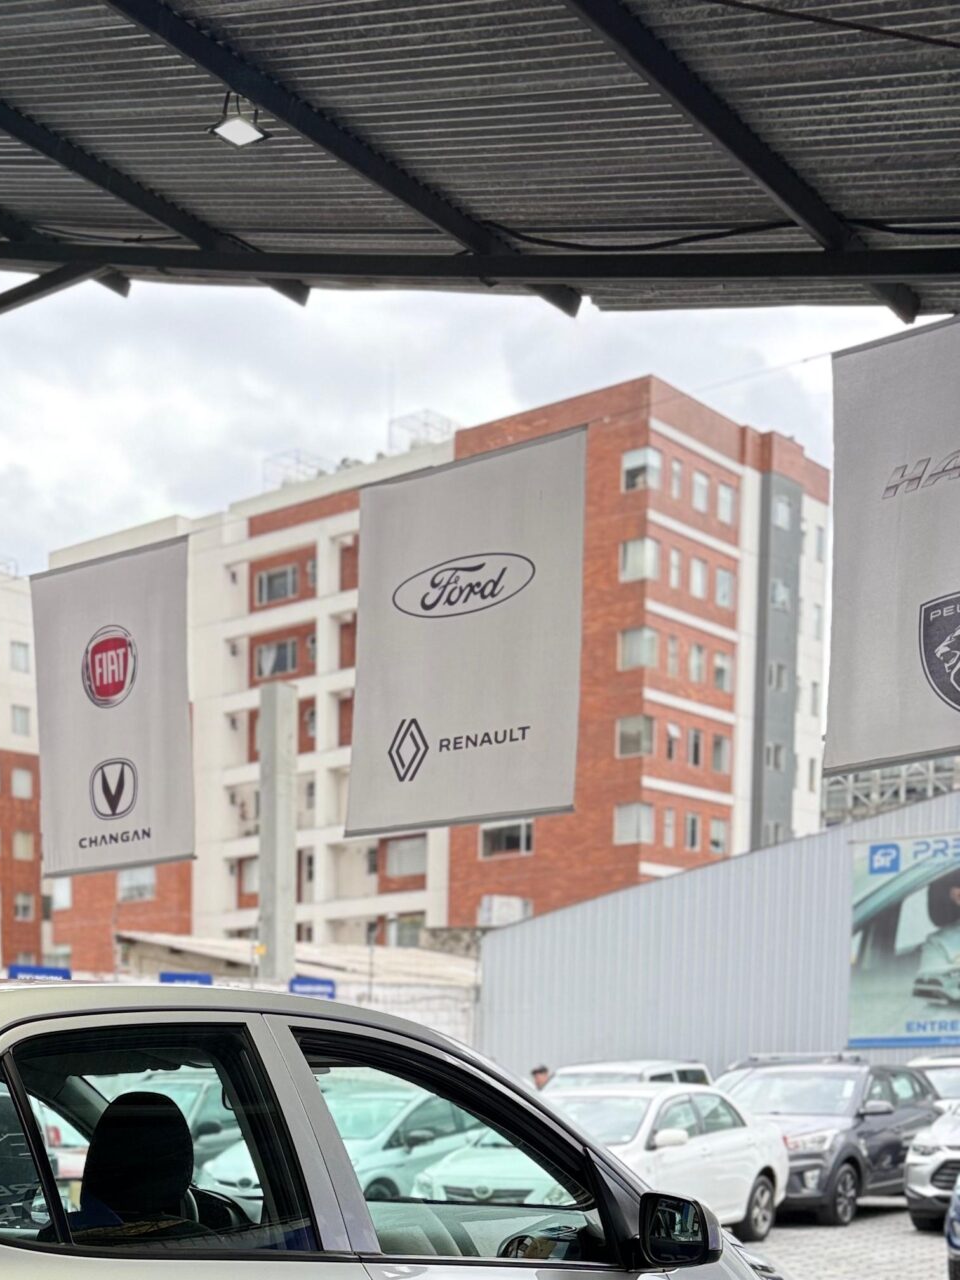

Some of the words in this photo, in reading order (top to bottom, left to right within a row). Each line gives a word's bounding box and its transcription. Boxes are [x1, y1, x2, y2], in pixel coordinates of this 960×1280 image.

[420, 562, 507, 611] Ford
[929, 605, 960, 622] PE
[95, 648, 126, 687] FIAT
[438, 725, 531, 752] RENAULT
[79, 827, 152, 849] CHANGAN
